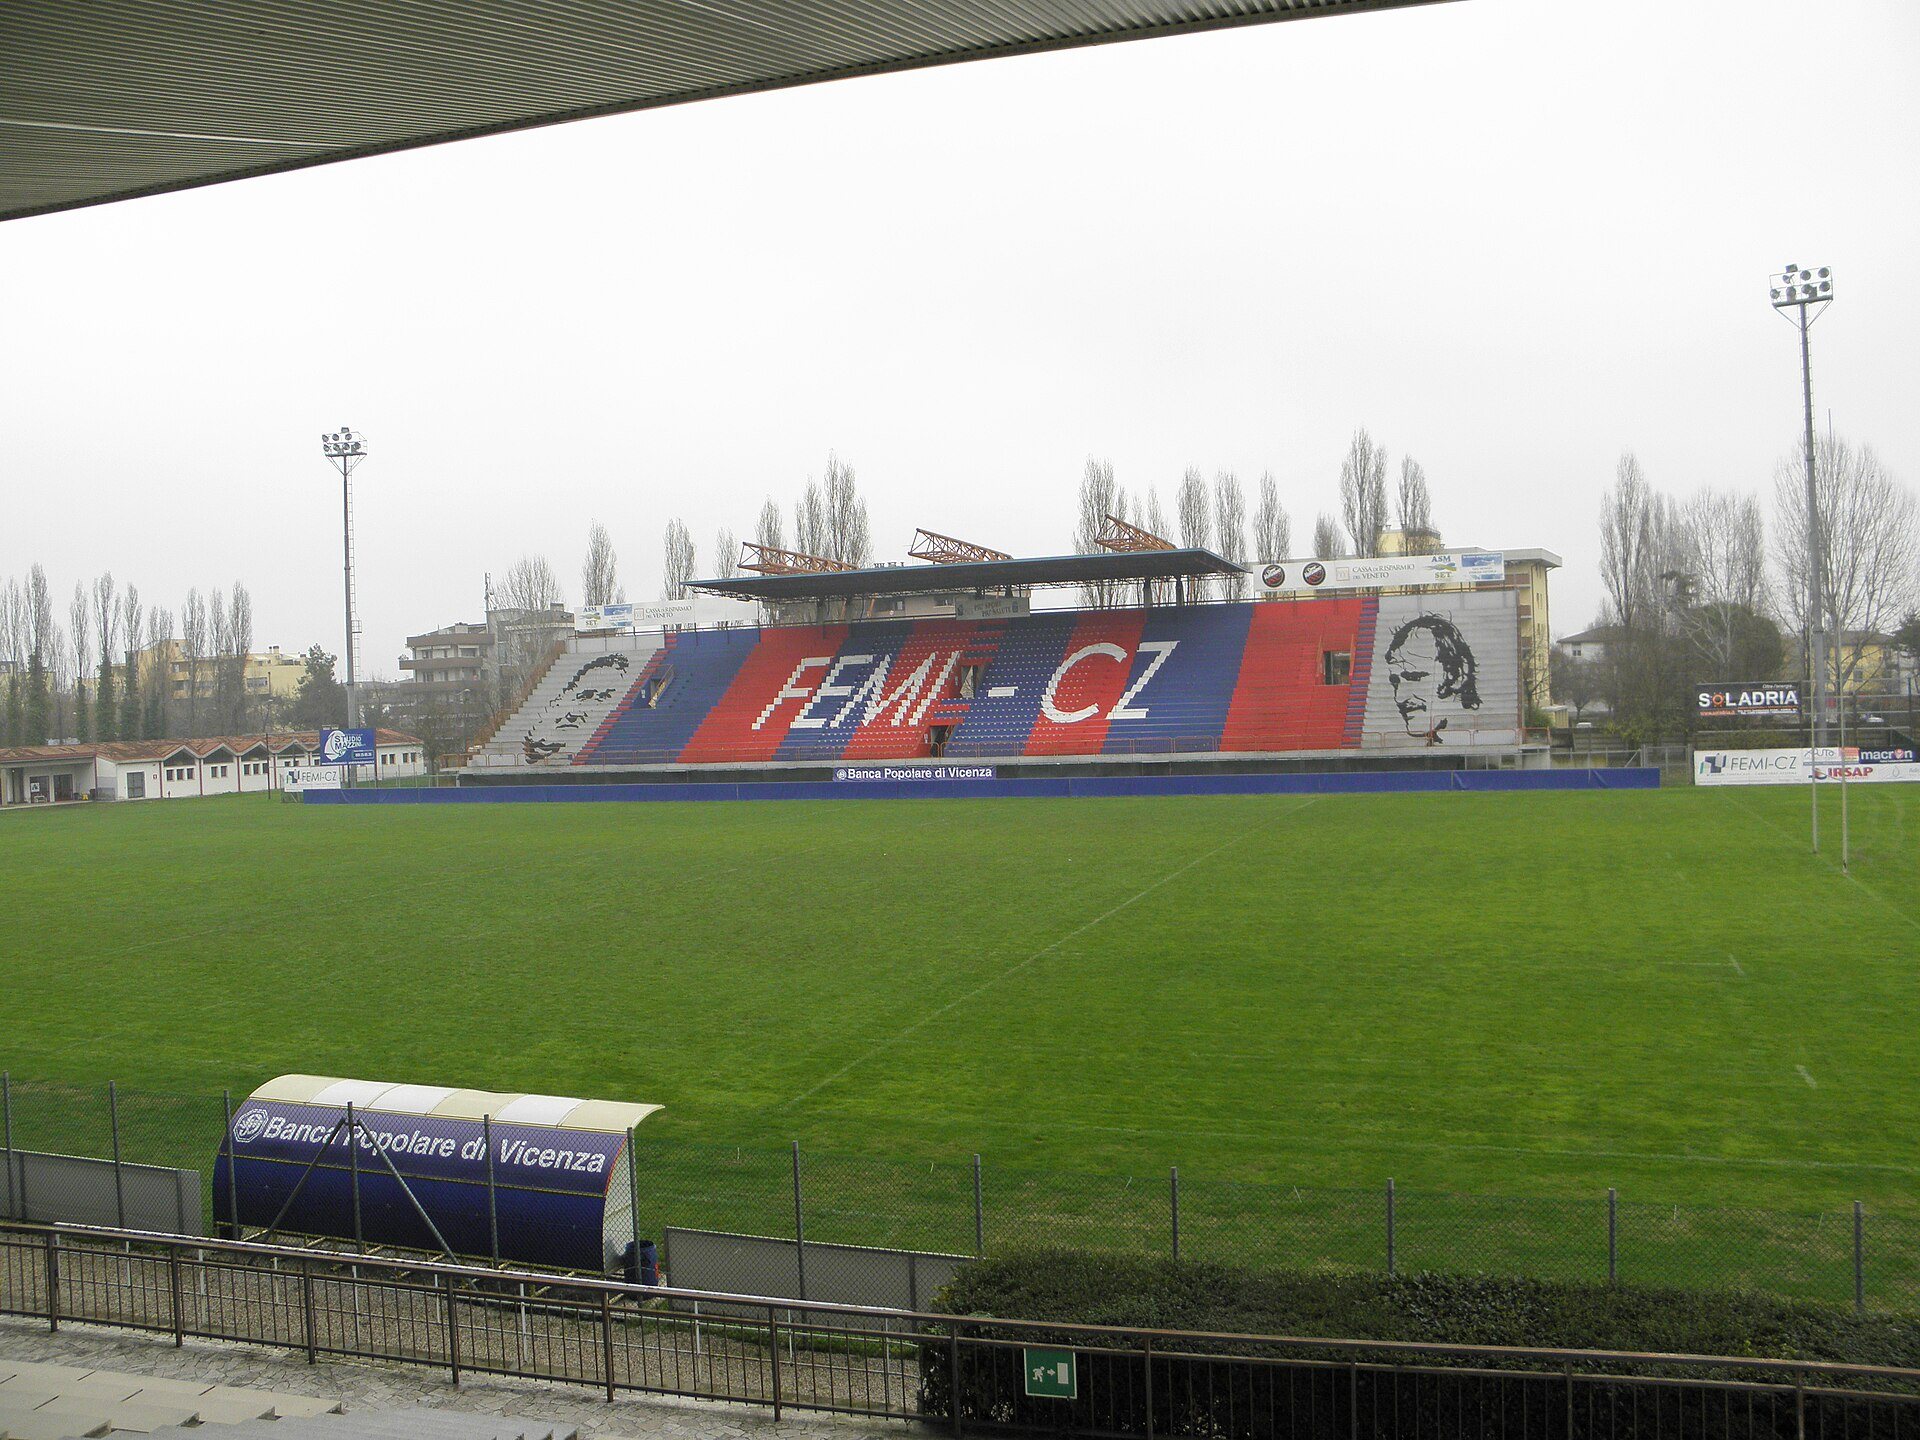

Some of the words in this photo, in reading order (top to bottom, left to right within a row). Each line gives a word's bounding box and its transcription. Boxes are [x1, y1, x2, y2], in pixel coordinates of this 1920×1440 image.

[1431, 555, 1451, 563] ASM
[1361, 571, 1390, 580] VENETO
[1434, 571, 1452, 579] SET
[583, 605, 597, 613] ASM
[1698, 690, 1799, 707] SOLADRIA
[1860, 749, 1913, 760] macron
[1730, 756, 1797, 771] FEMI-CZ
[301, 771, 337, 782] FEMI-CZ
[848, 768, 882, 779] Banca
[884, 767, 932, 780] Popolare
[934, 767, 945, 778] di
[947, 766, 993, 778] Vicenza
[1828, 767, 1873, 777] IRSAP
[343, 1124, 456, 1158] Popolare
[500, 1138, 606, 1173] Vicenza
